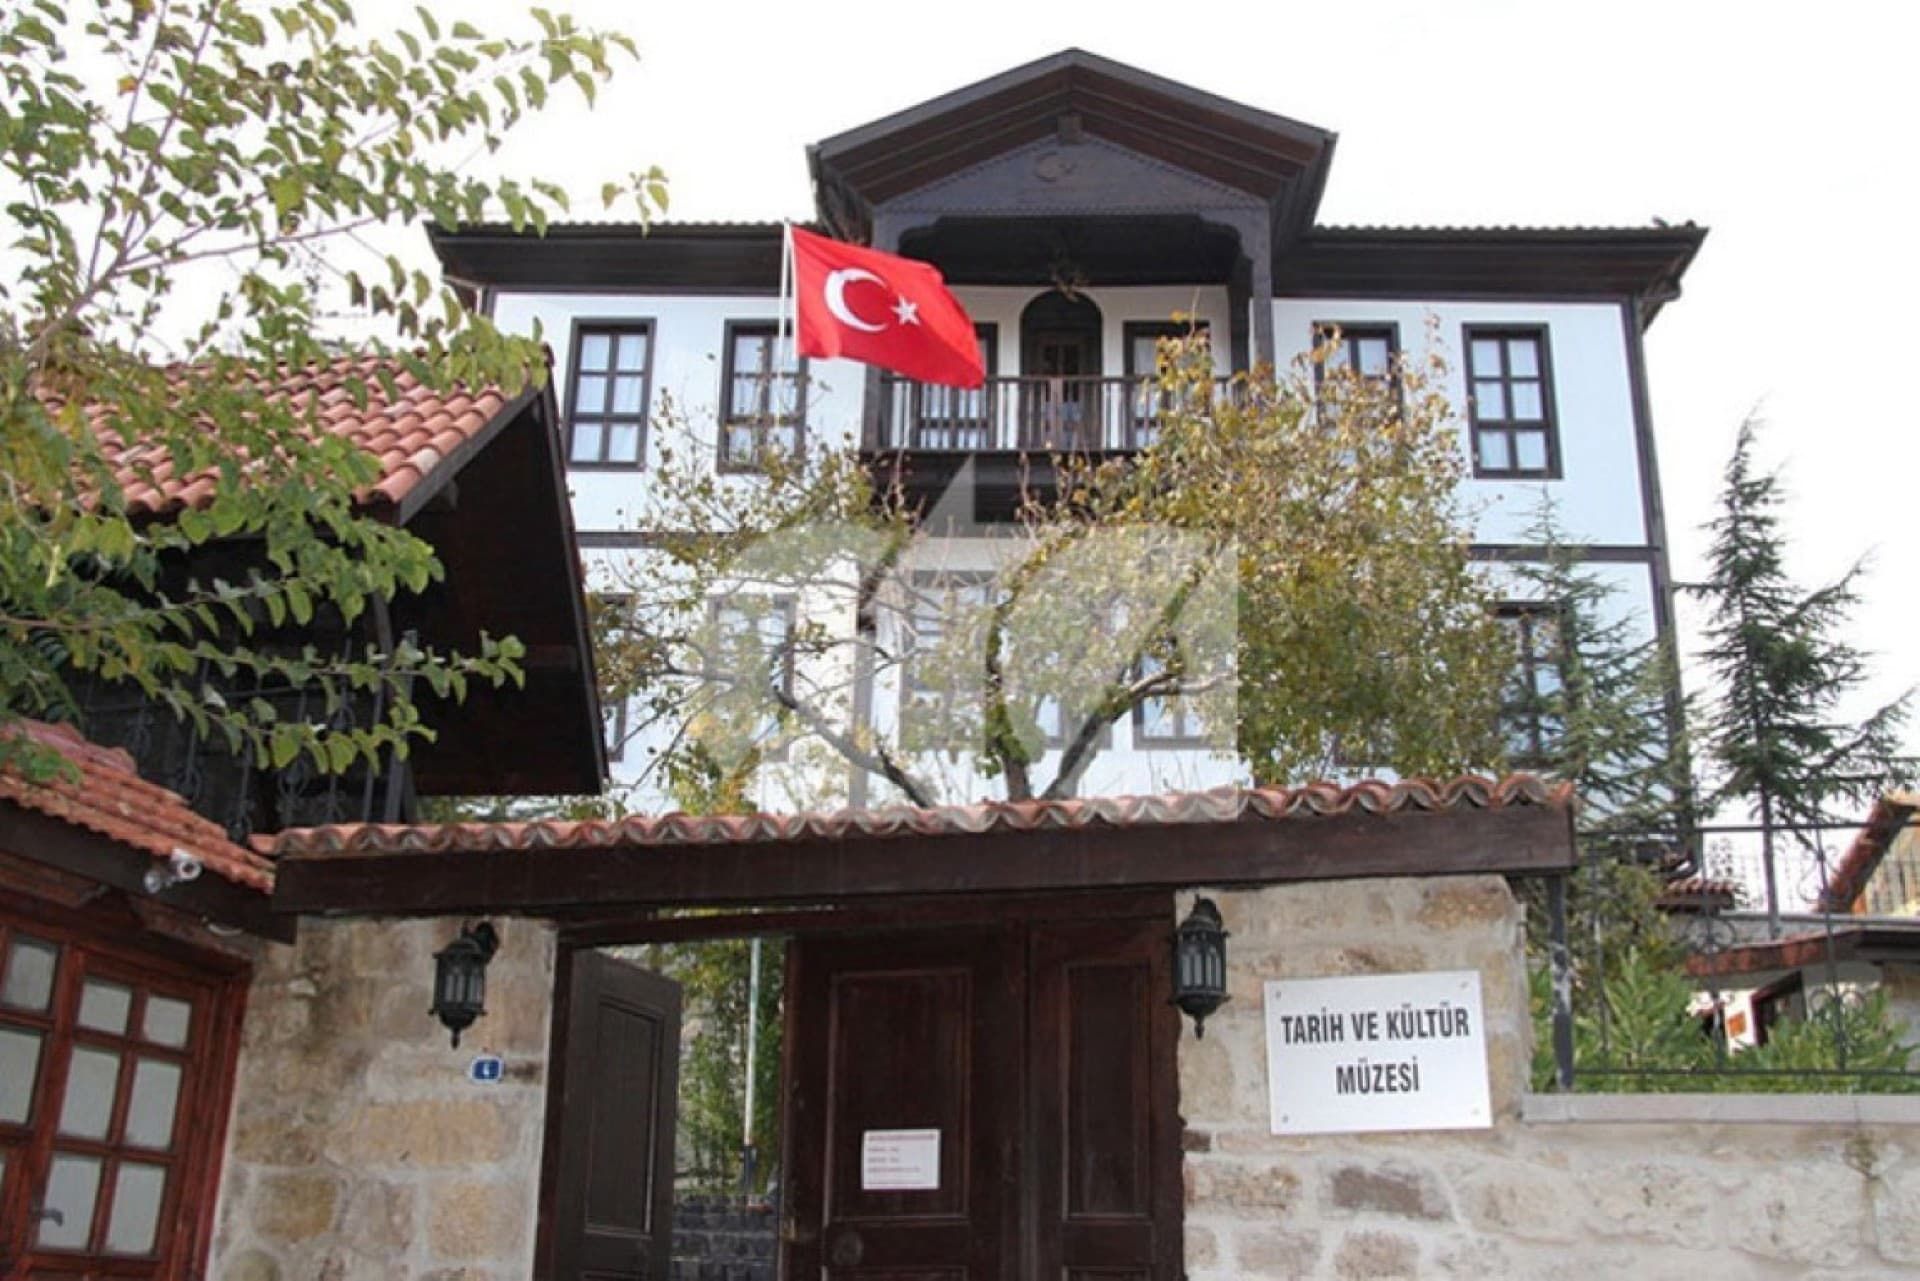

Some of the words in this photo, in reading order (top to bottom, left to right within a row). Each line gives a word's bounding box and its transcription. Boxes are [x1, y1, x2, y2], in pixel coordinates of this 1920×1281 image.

[1281, 1007, 1344, 1044] TARİH
[1351, 1012, 1379, 1041] VE
[1386, 1002, 1469, 1040] KÜLTÜR
[1336, 1056, 1419, 1094] MÜZESİ
